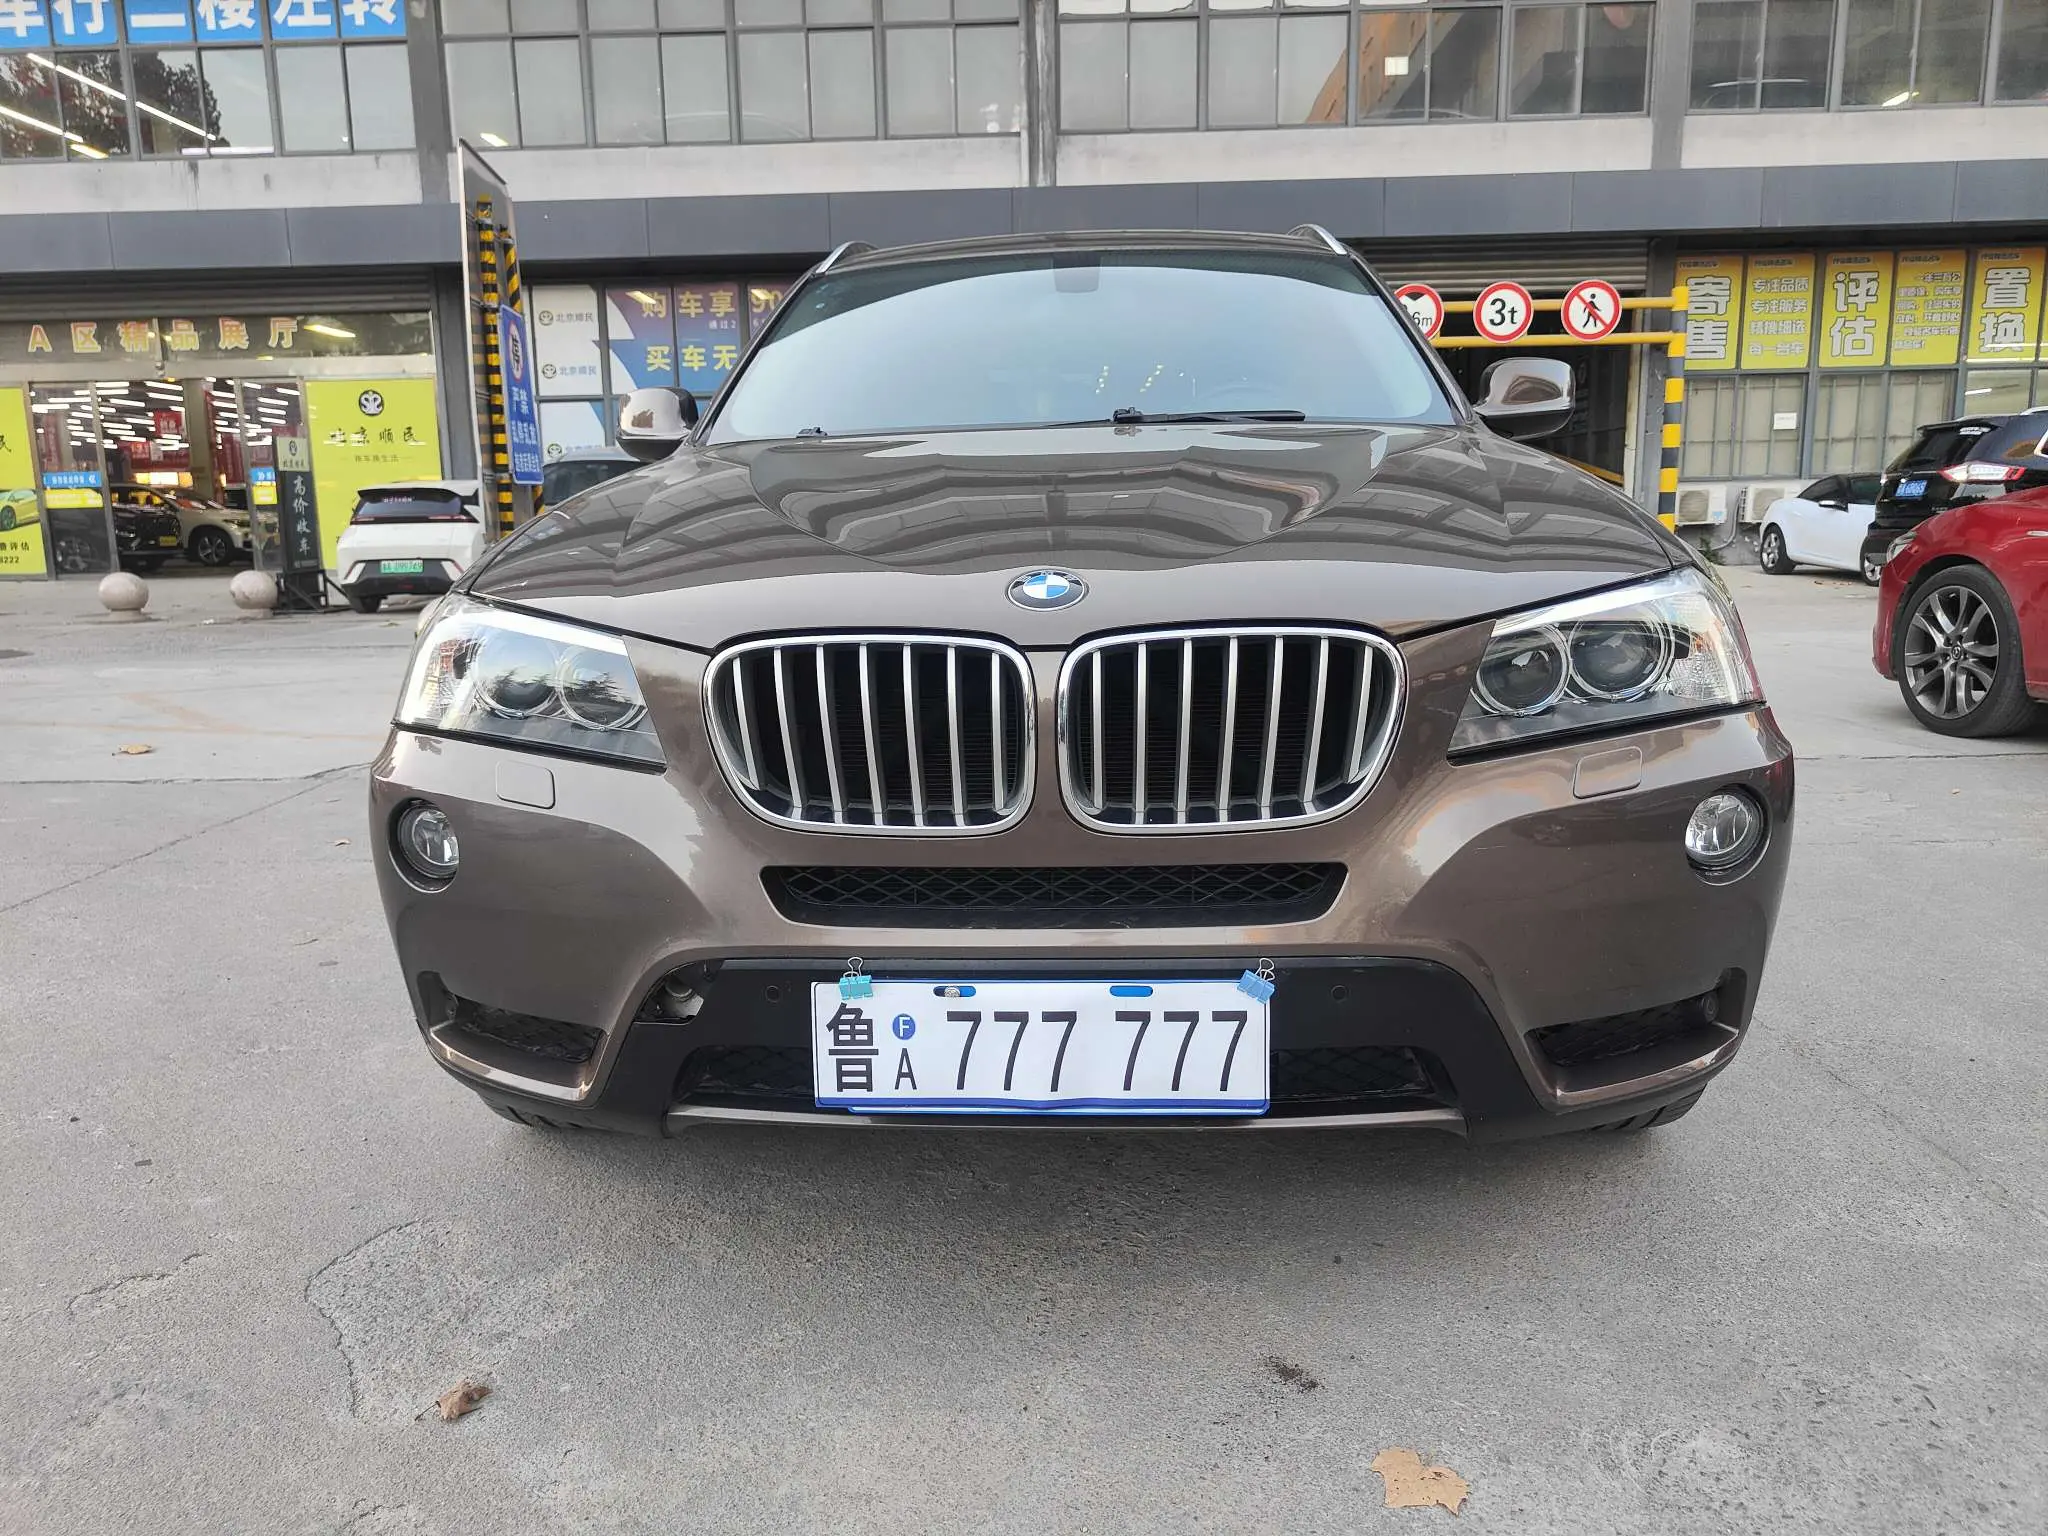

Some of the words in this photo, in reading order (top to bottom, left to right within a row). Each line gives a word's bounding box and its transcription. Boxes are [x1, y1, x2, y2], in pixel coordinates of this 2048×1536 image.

[1489, 298, 1518, 327] 3t
[1686, 275, 1732, 360] 寄售
[1830, 270, 1880, 357] 评估
[1979, 266, 2031, 354] 置换
[647, 344, 738, 372] 买车无
[292, 474, 312, 556] 高价收车
[825, 1002, 879, 1093] 鲁
[894, 1048, 918, 1091] A
[946, 1010, 1077, 1092] 777
[1115, 1010, 1248, 1092] 777
